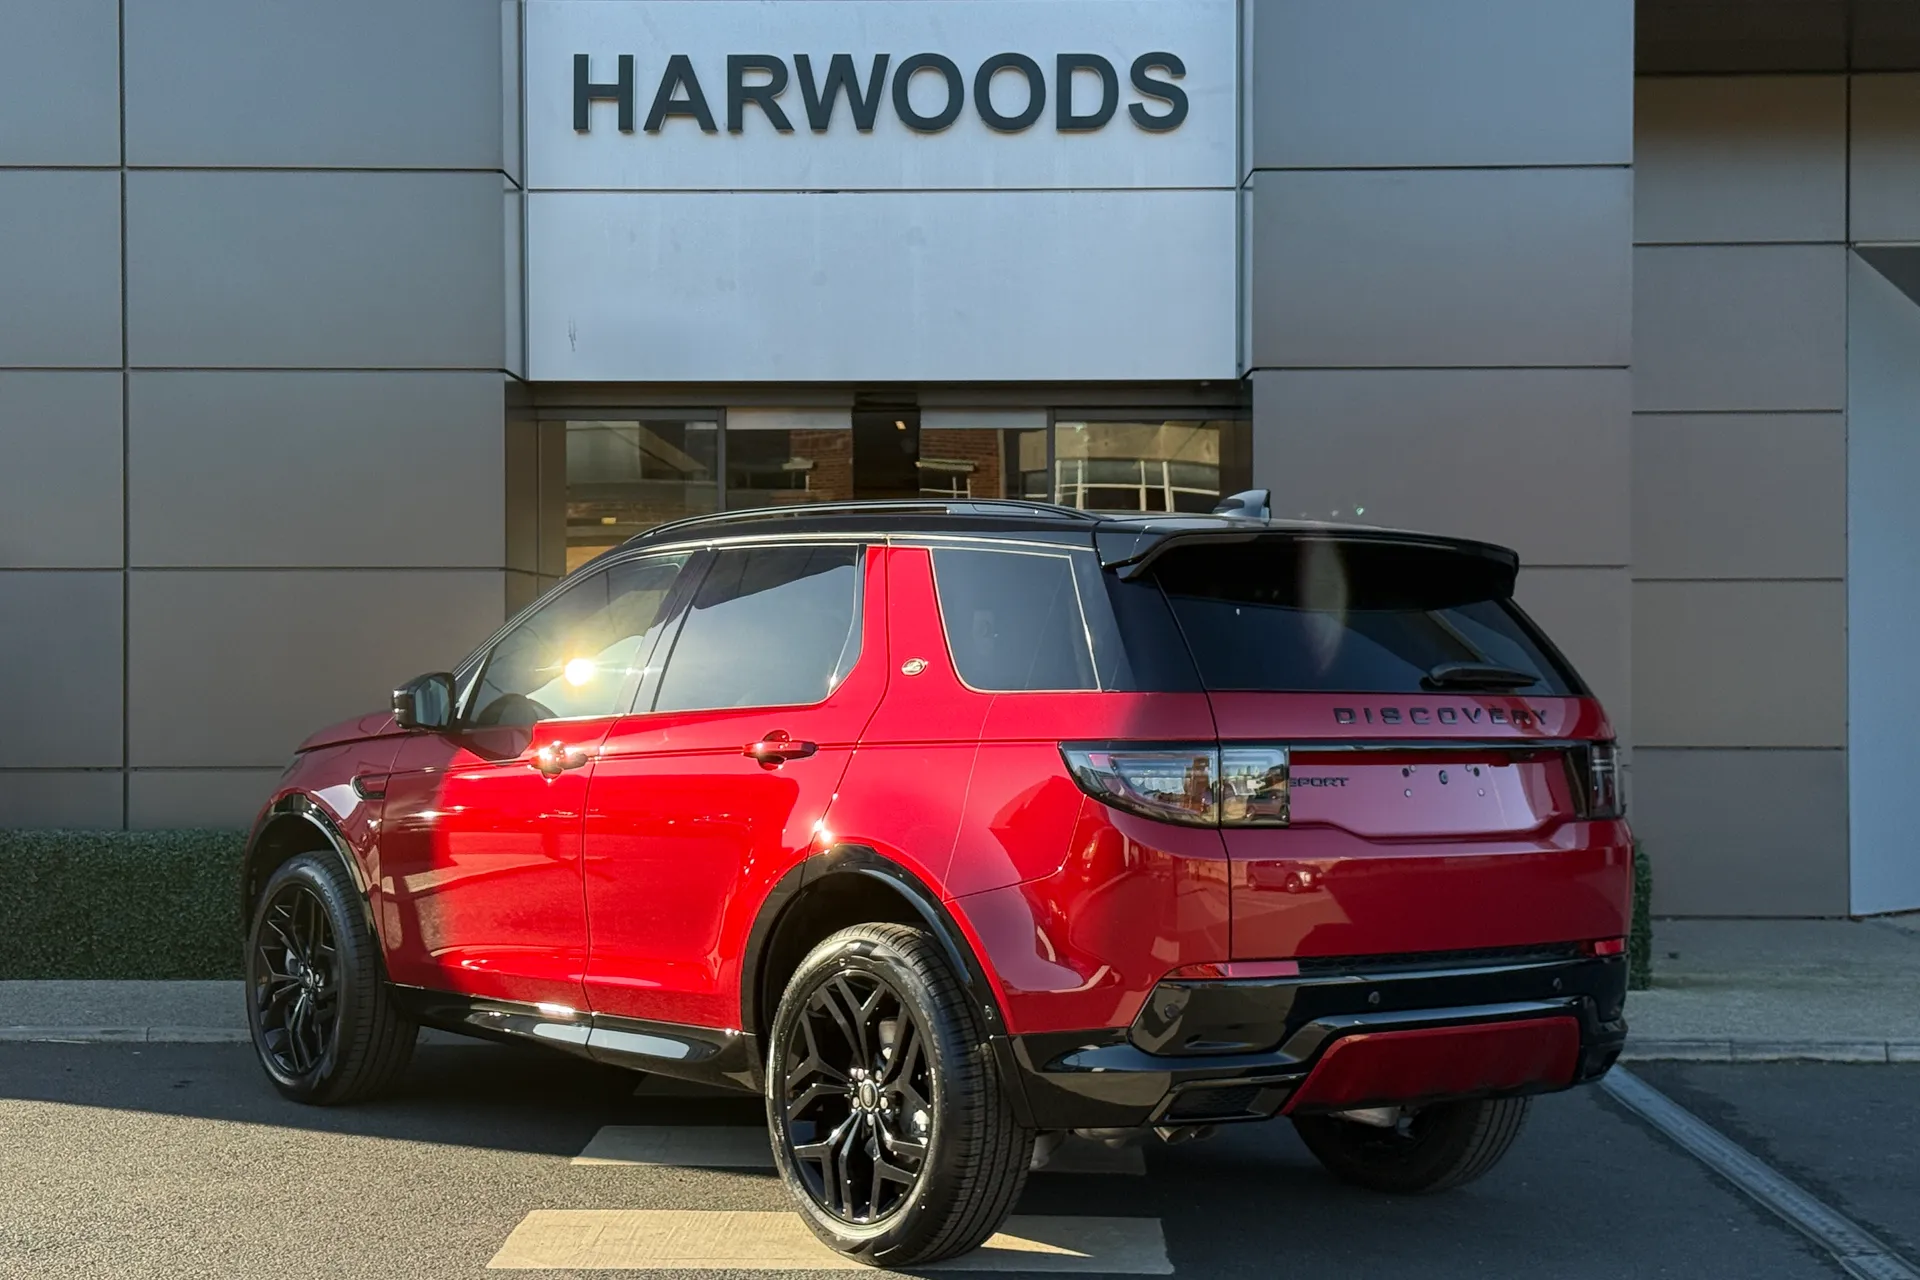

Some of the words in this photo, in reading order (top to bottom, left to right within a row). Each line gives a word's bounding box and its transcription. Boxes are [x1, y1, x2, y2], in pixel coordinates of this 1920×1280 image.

[573, 51, 1189, 133] HARWOODS
[1333, 707, 1547, 725] DISCOVERY
[1289, 777, 1349, 787] SPORT
